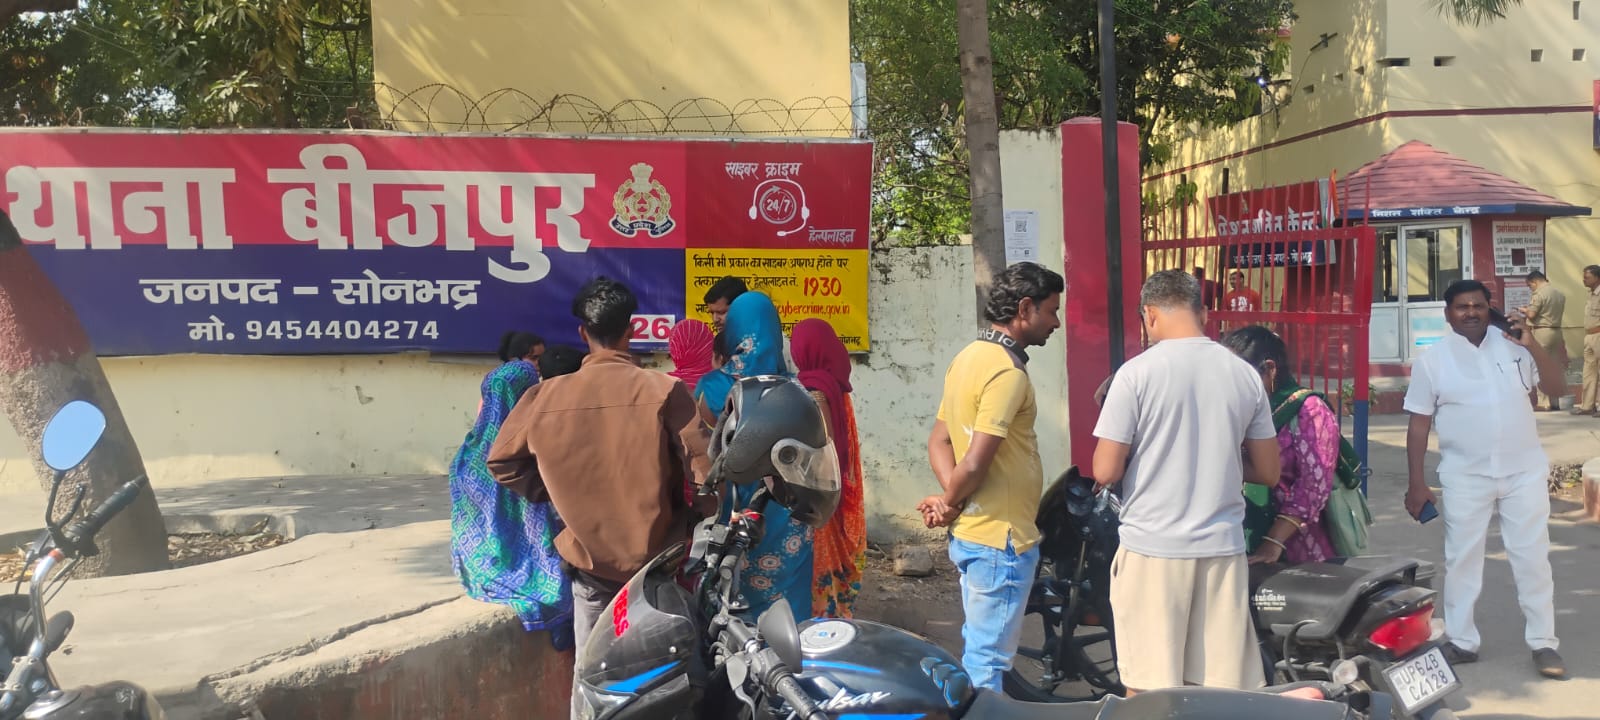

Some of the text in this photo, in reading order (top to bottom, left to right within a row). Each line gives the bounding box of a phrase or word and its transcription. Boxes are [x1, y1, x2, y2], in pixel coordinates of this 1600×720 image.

[725, 161, 803, 180] साइबर क्राइम
[5, 143, 596, 283] थाना बीजपुर
[766, 196, 791, 214] 24/7
[808, 225, 856, 246] हेल्पलाइन
[693, 252, 715, 271] किसी
[716, 253, 727, 268] भी
[728, 257, 749, 271] प्रकार
[750, 257, 761, 268] का
[790, 257, 815, 271] अपराध
[836, 258, 849, 272] पर
[139, 279, 281, 305] जनपद
[331, 269, 481, 310] सोनभद्र
[803, 277, 842, 297] 1930
[776, 300, 850, 319] cybercrime.gov.in
[187, 315, 440, 341] मो. 9454404274
[1400, 652, 1440, 685] UP64B
[1408, 670, 1449, 701] C4128
